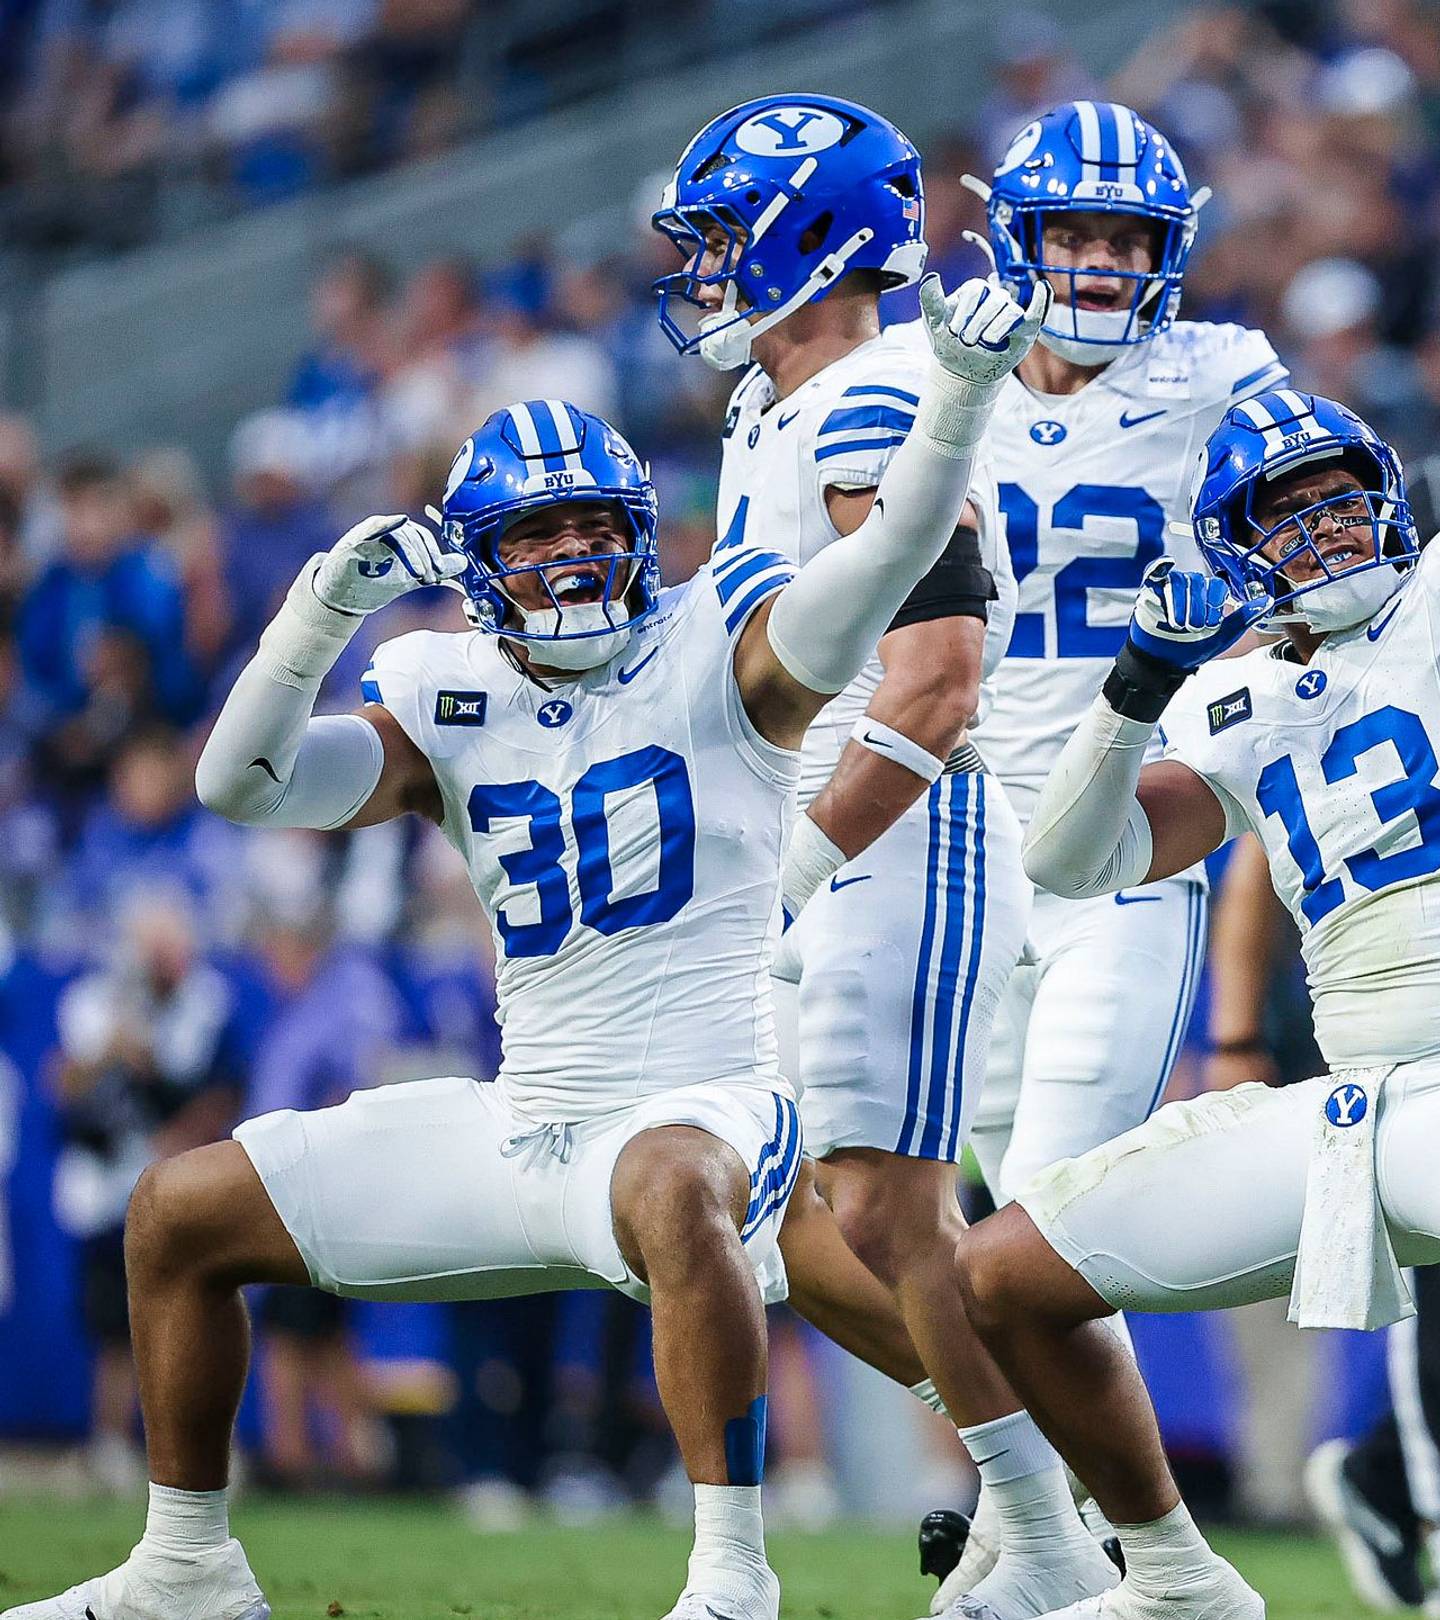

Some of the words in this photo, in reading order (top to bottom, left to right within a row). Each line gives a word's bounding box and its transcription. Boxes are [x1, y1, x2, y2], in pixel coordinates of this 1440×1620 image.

[751, 113, 823, 150] Y
[1095, 184, 1123, 199] BYU
[1282, 432, 1312, 449] BYU
[544, 473, 574, 488] BYU
[468, 744, 696, 958] 30
[1332, 1086, 1366, 1125] Y
